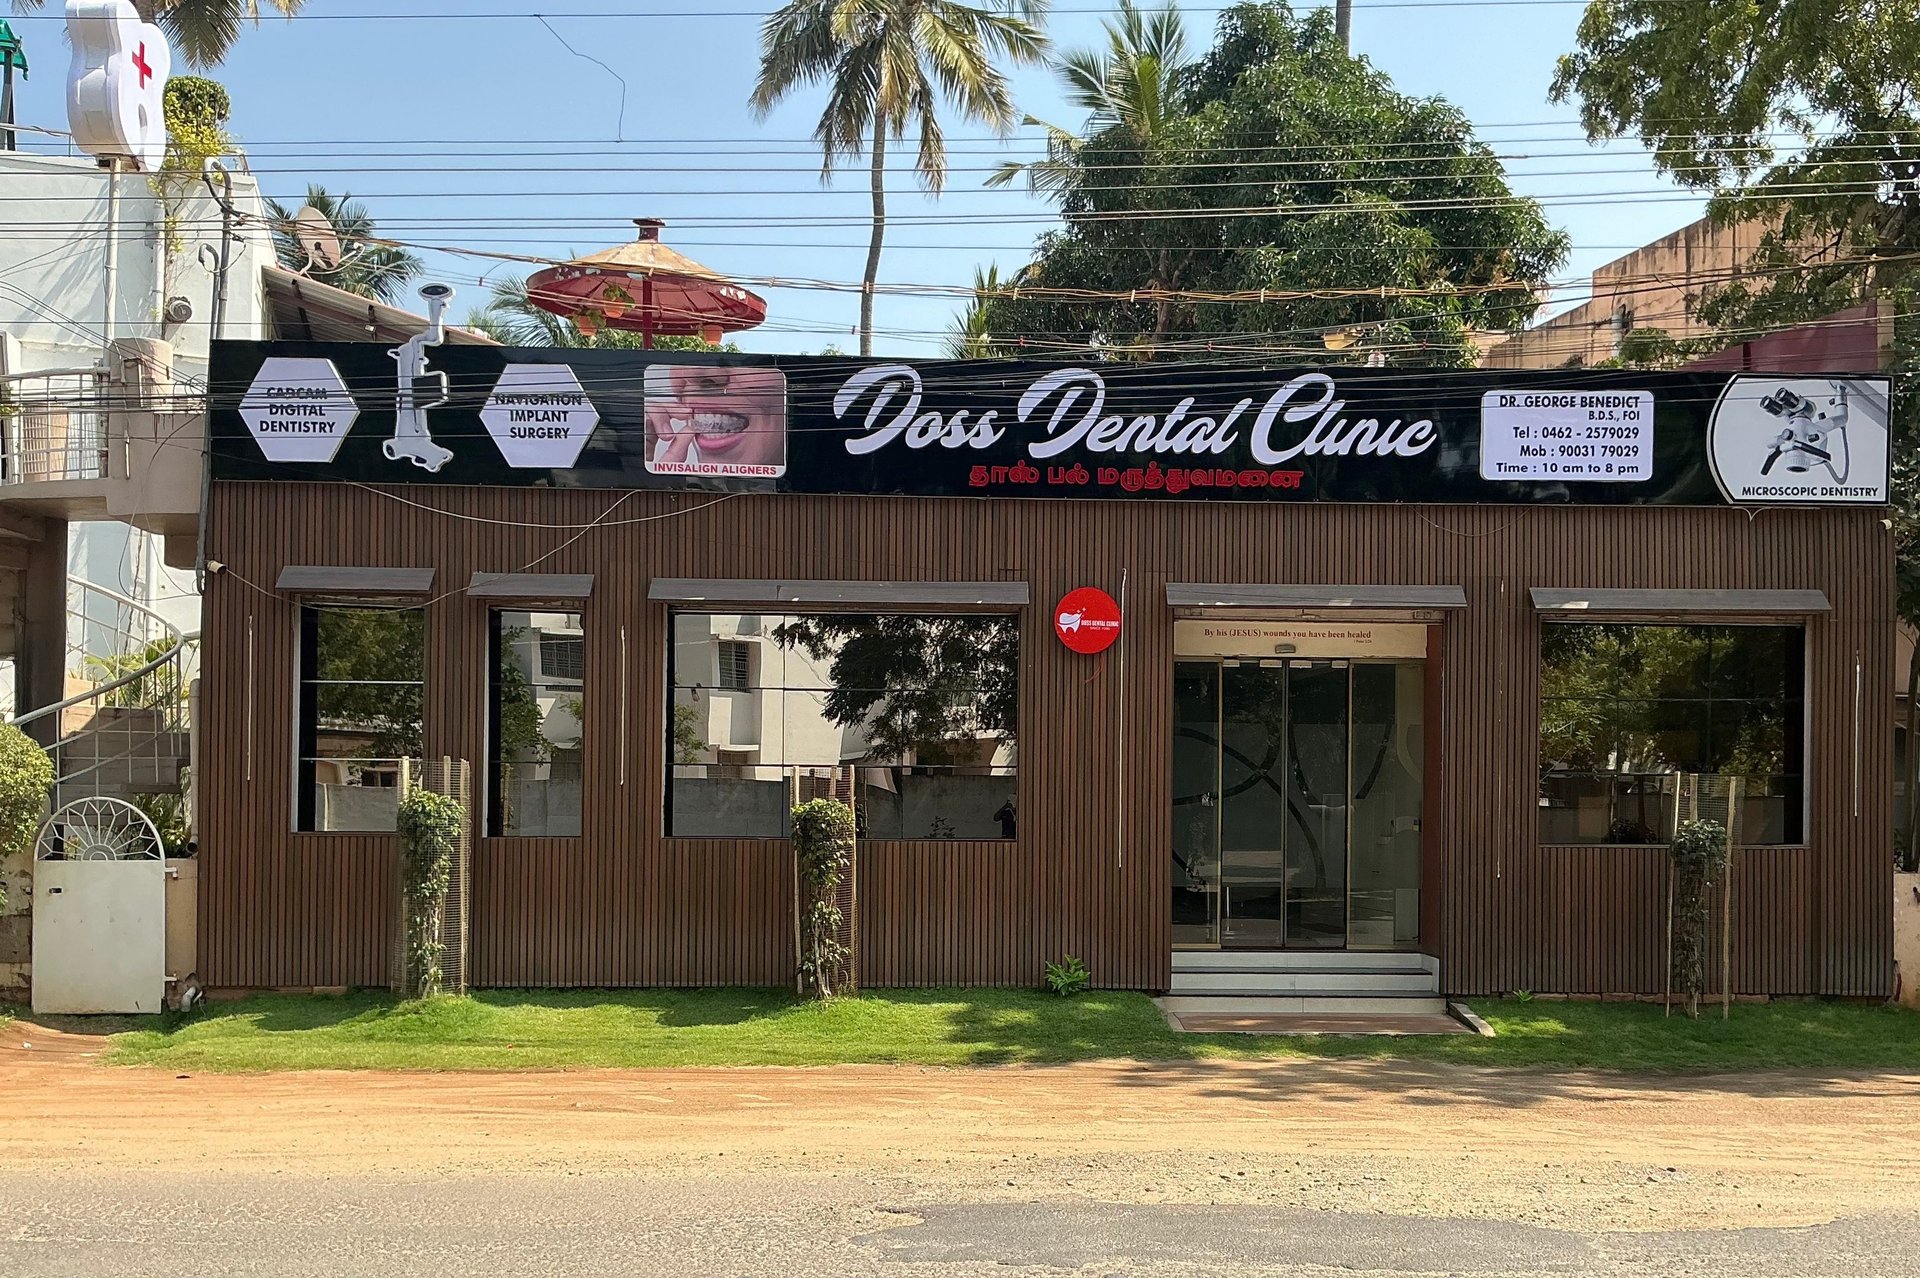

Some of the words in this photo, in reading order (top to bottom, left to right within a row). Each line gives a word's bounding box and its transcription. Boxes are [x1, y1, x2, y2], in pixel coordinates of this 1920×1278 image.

[495, 393, 582, 406] NAVIGATION
[1499, 396, 1520, 408] DR.
[1524, 396, 1576, 408] GEORGE
[1580, 396, 1640, 408] BENEDICT
[269, 404, 326, 416] DIGITAL
[510, 409, 569, 422] IMPLANT
[833, 363, 1006, 455] Doss
[1017, 367, 1253, 459] Dental
[1250, 372, 1438, 466] Clinic
[1588, 411, 1620, 422] B.D.S.,
[1623, 411, 1640, 421] FOI
[260, 420, 336, 433] DENTISTRY
[510, 427, 570, 439] SURGERY
[1513, 427, 1530, 439] Tel
[1542, 427, 1572, 439] 0462
[1586, 427, 1639, 439] 2579029
[1520, 445, 1547, 457] Mob
[1559, 446, 1595, 457] 90031
[1601, 446, 1639, 457] 79029
[654, 463, 718, 473] INVISALIGN
[722, 465, 777, 475] ALIGNERS
[1496, 463, 1528, 473] Time
[1543, 463, 1557, 473] 10
[1563, 465, 1583, 473] am
[1588, 464, 1600, 473] to
[1605, 463, 1613, 473] 8
[1618, 465, 1639, 475] pm
[969, 460, 1040, 486] தாஸ்
[1048, 463, 1089, 485] பல்
[1098, 461, 1304, 494] மருத்துவமனை
[1742, 487, 1817, 496] MICROSCOPIC
[1821, 487, 1879, 496] DENTISTRY
[1204, 629, 1214, 637] By
[1229, 629, 1261, 637] (JESUS)
[1293, 631, 1307, 639] you
